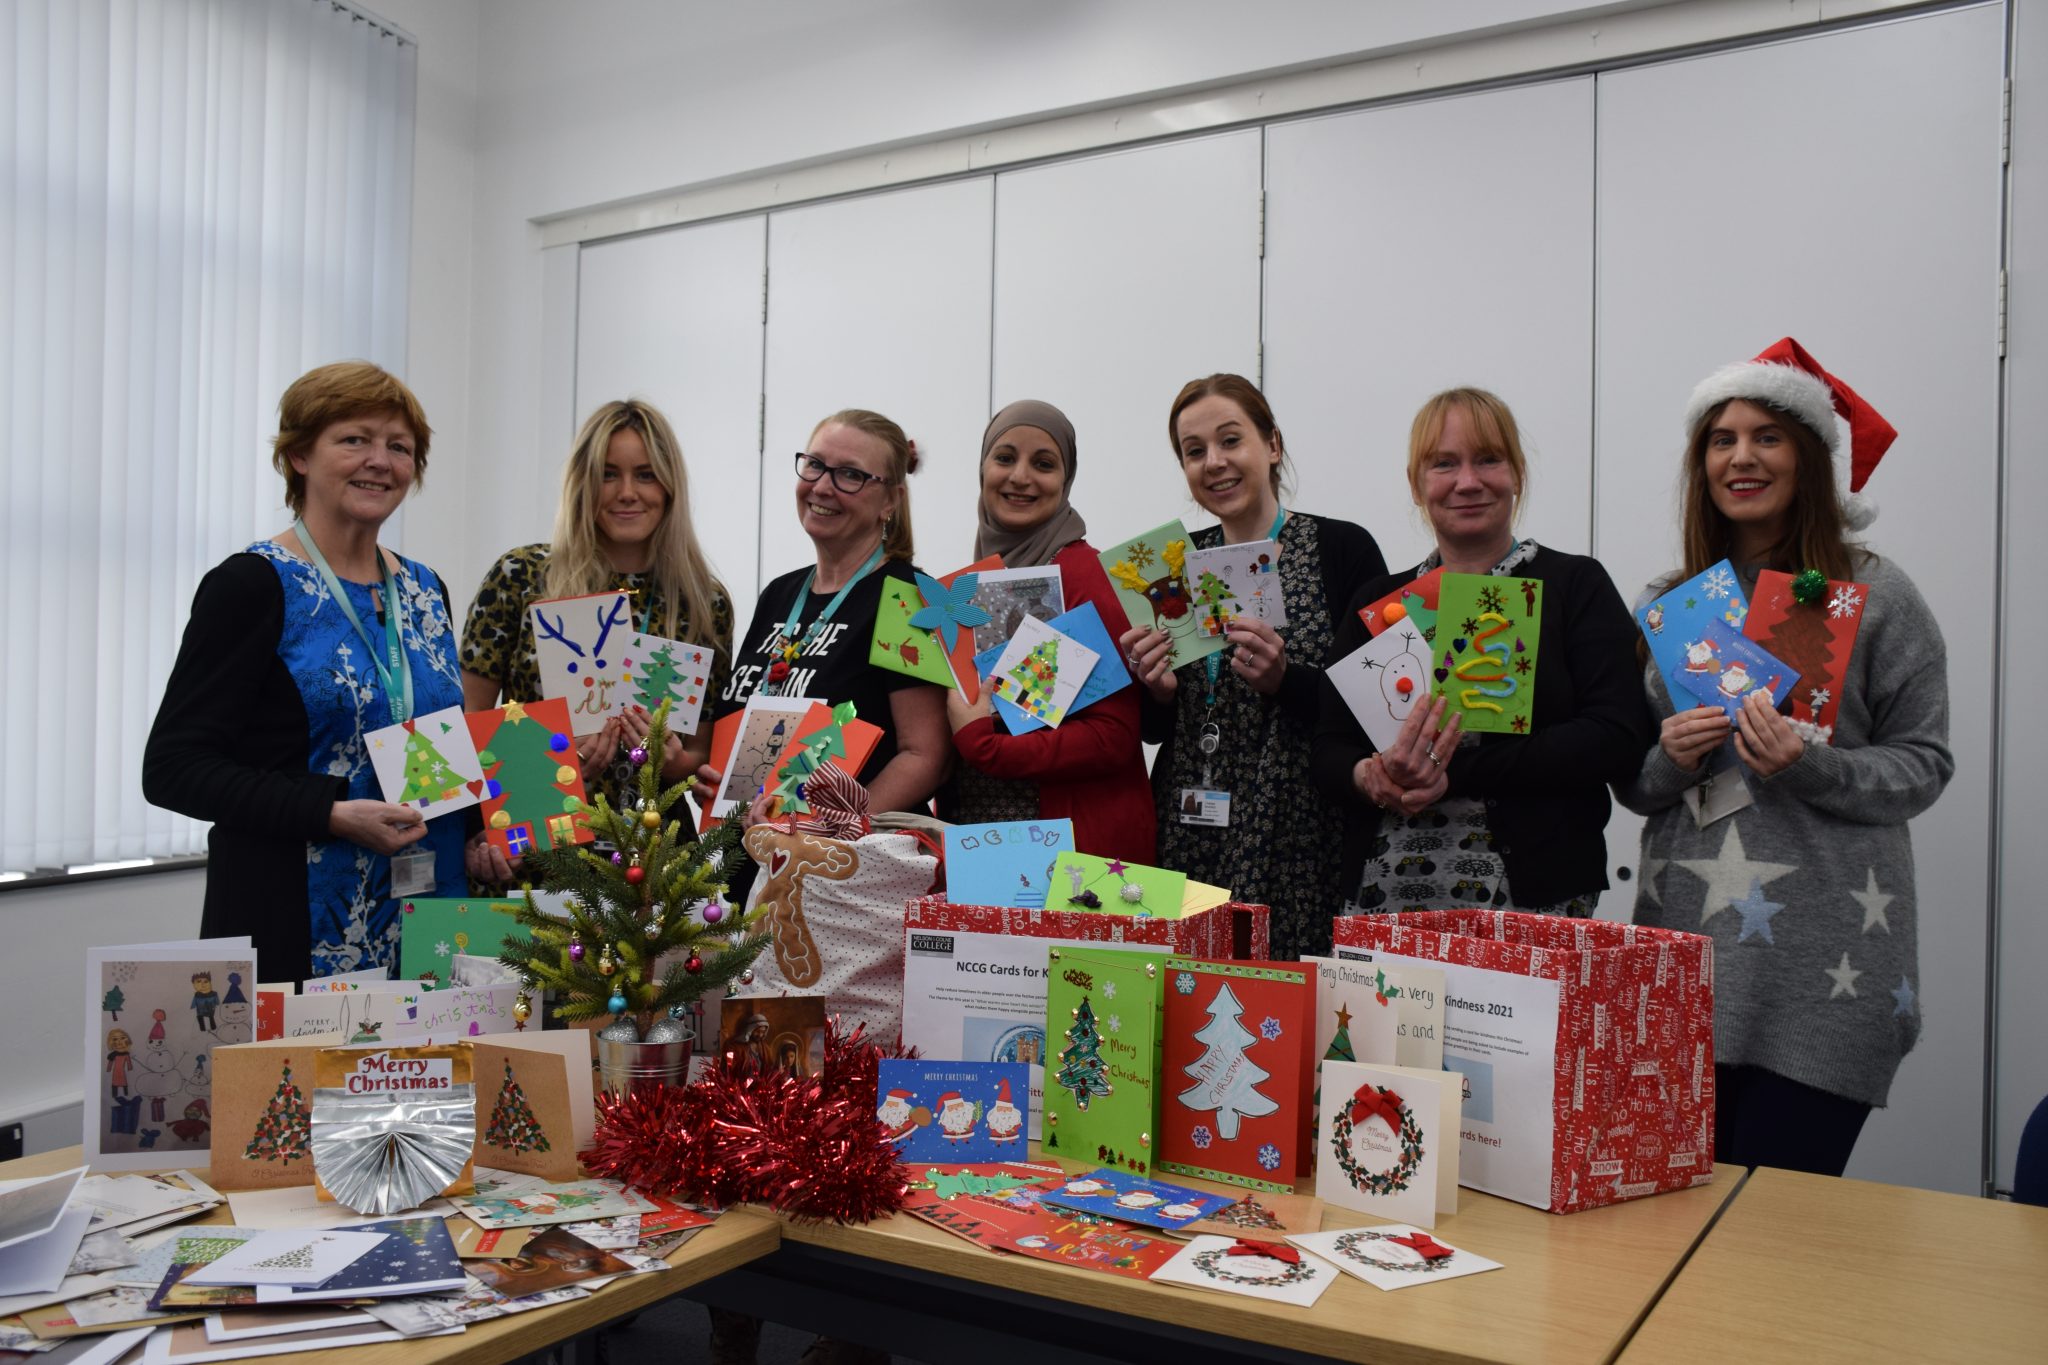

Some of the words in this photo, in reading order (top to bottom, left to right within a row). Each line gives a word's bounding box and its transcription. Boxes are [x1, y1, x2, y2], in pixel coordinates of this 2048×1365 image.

[913, 941, 952, 951] COLLEGE
[956, 961, 987, 974] NCCG
[990, 964, 1020, 976] Cards
[1023, 966, 1039, 978] for
[1339, 967, 1374, 987] Christmas
[1444, 995, 1485, 1013] Kindness
[1487, 1003, 1514, 1018] 2021
[1412, 1025, 1436, 1040] and
[1111, 1039, 1137, 1059] Merry
[362, 1057, 428, 1075] Merry
[1195, 1044, 1228, 1086] HAPPY
[348, 1075, 449, 1094] Christmas
[924, 1073, 943, 1081] MERRY
[945, 1073, 979, 1082] CHRISTMAS
[1111, 1065, 1150, 1089] Christmas
[1478, 1133, 1502, 1148] here!
[1594, 1161, 1620, 1173] snow
